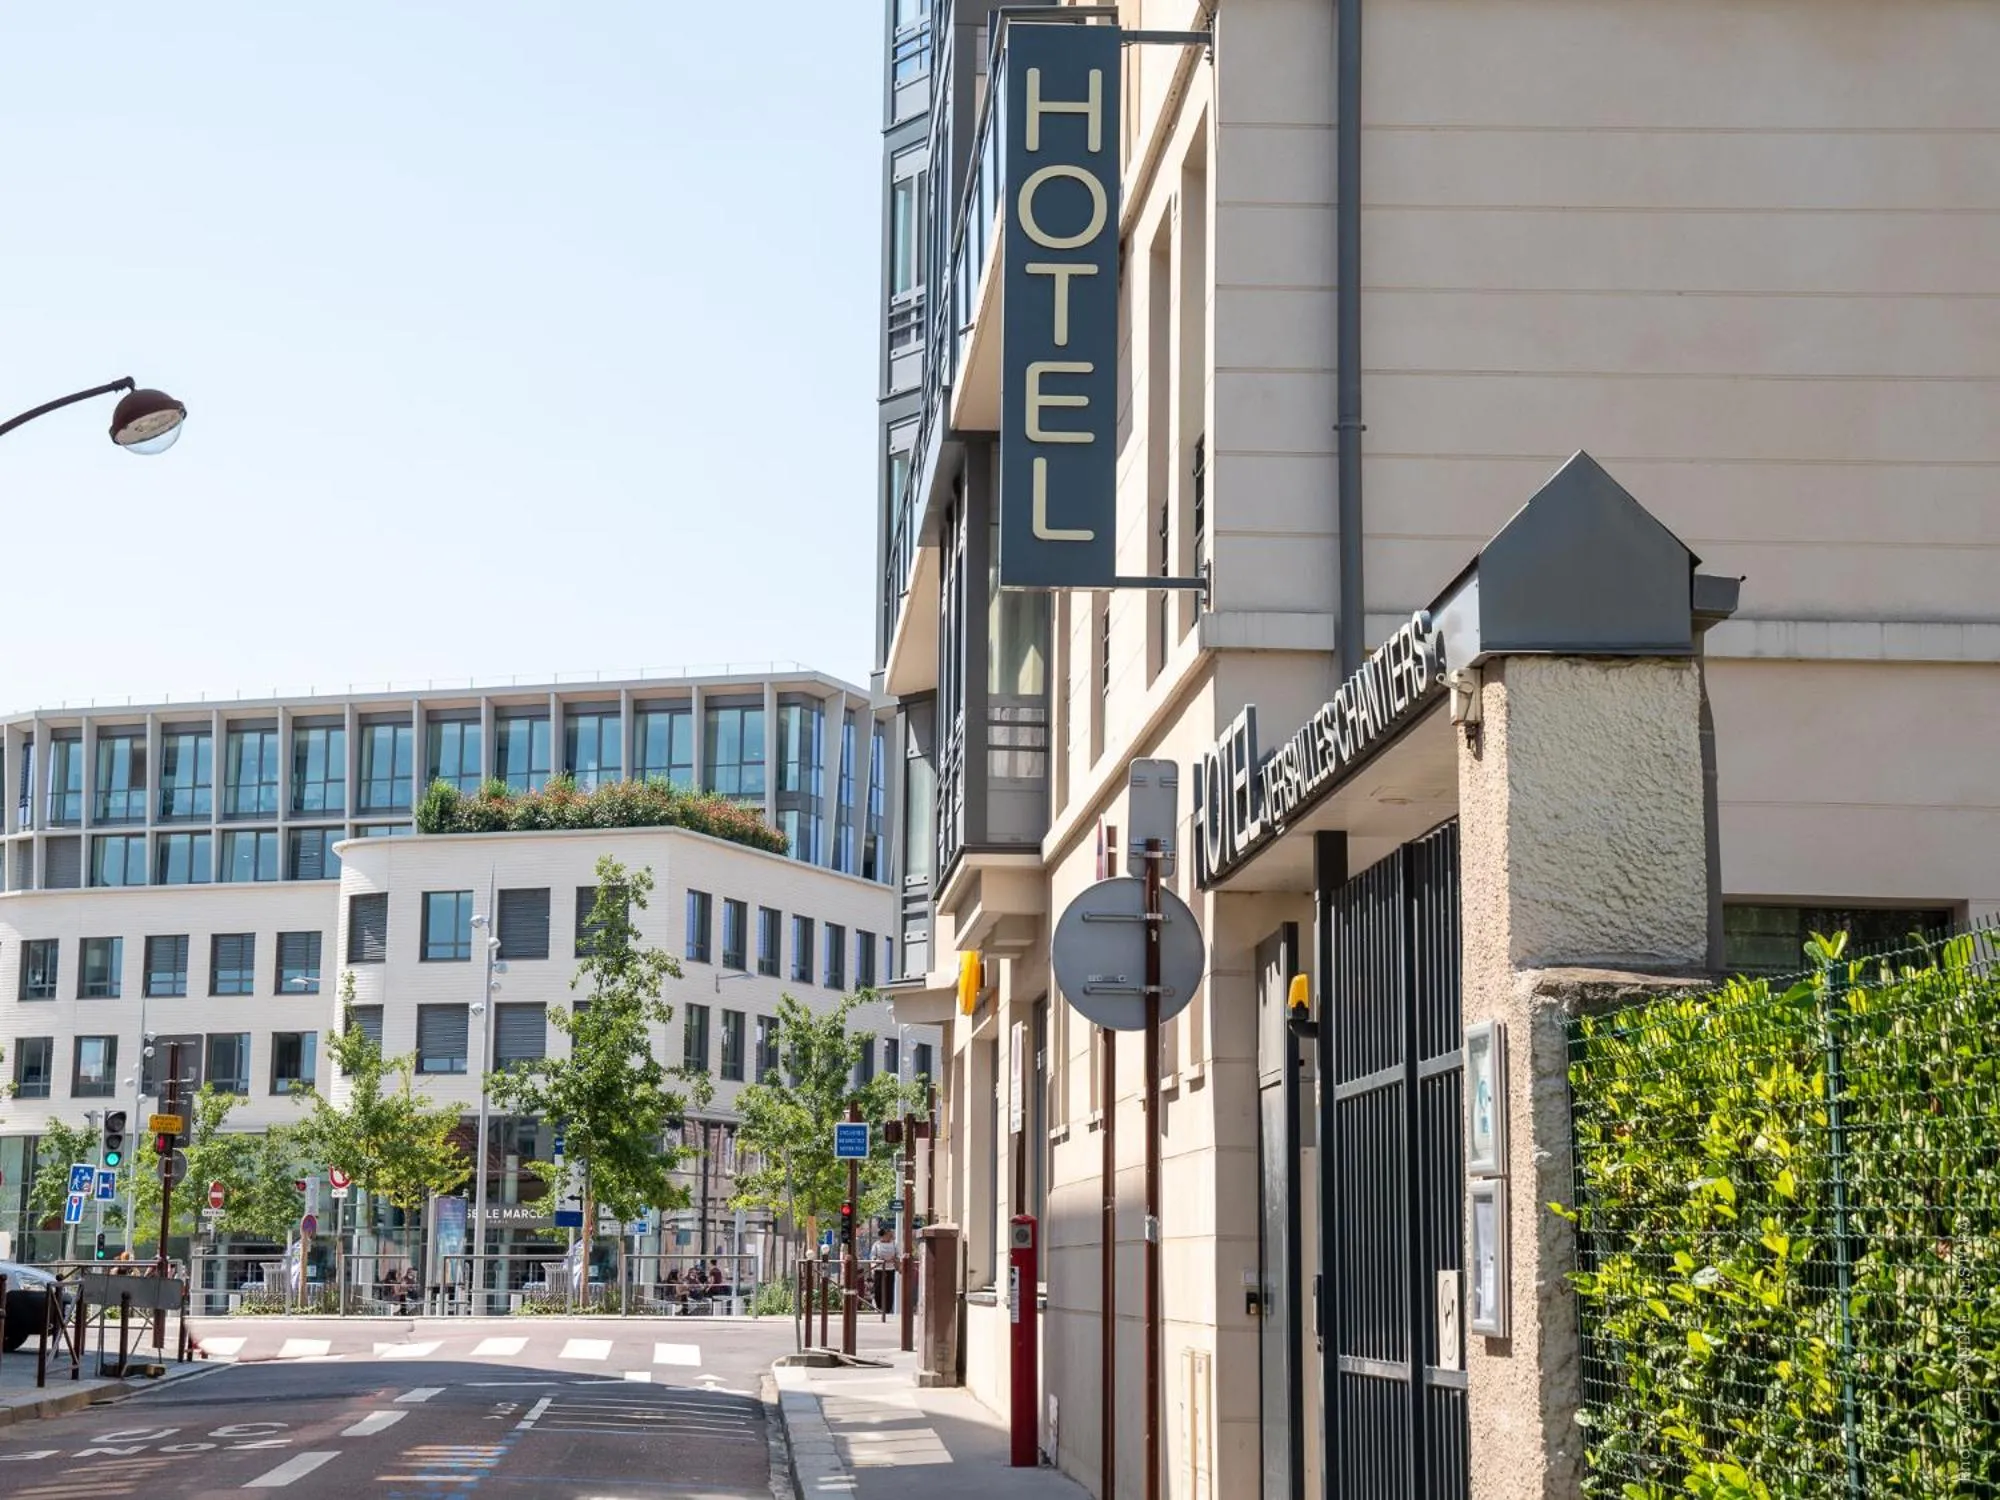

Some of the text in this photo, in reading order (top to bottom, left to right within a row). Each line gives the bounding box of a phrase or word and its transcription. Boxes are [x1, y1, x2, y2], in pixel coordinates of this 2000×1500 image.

[1018, 67, 1108, 541] HOTEL
[1194, 610, 1432, 889] HOTEL VERSAILLES CHANTIERS
